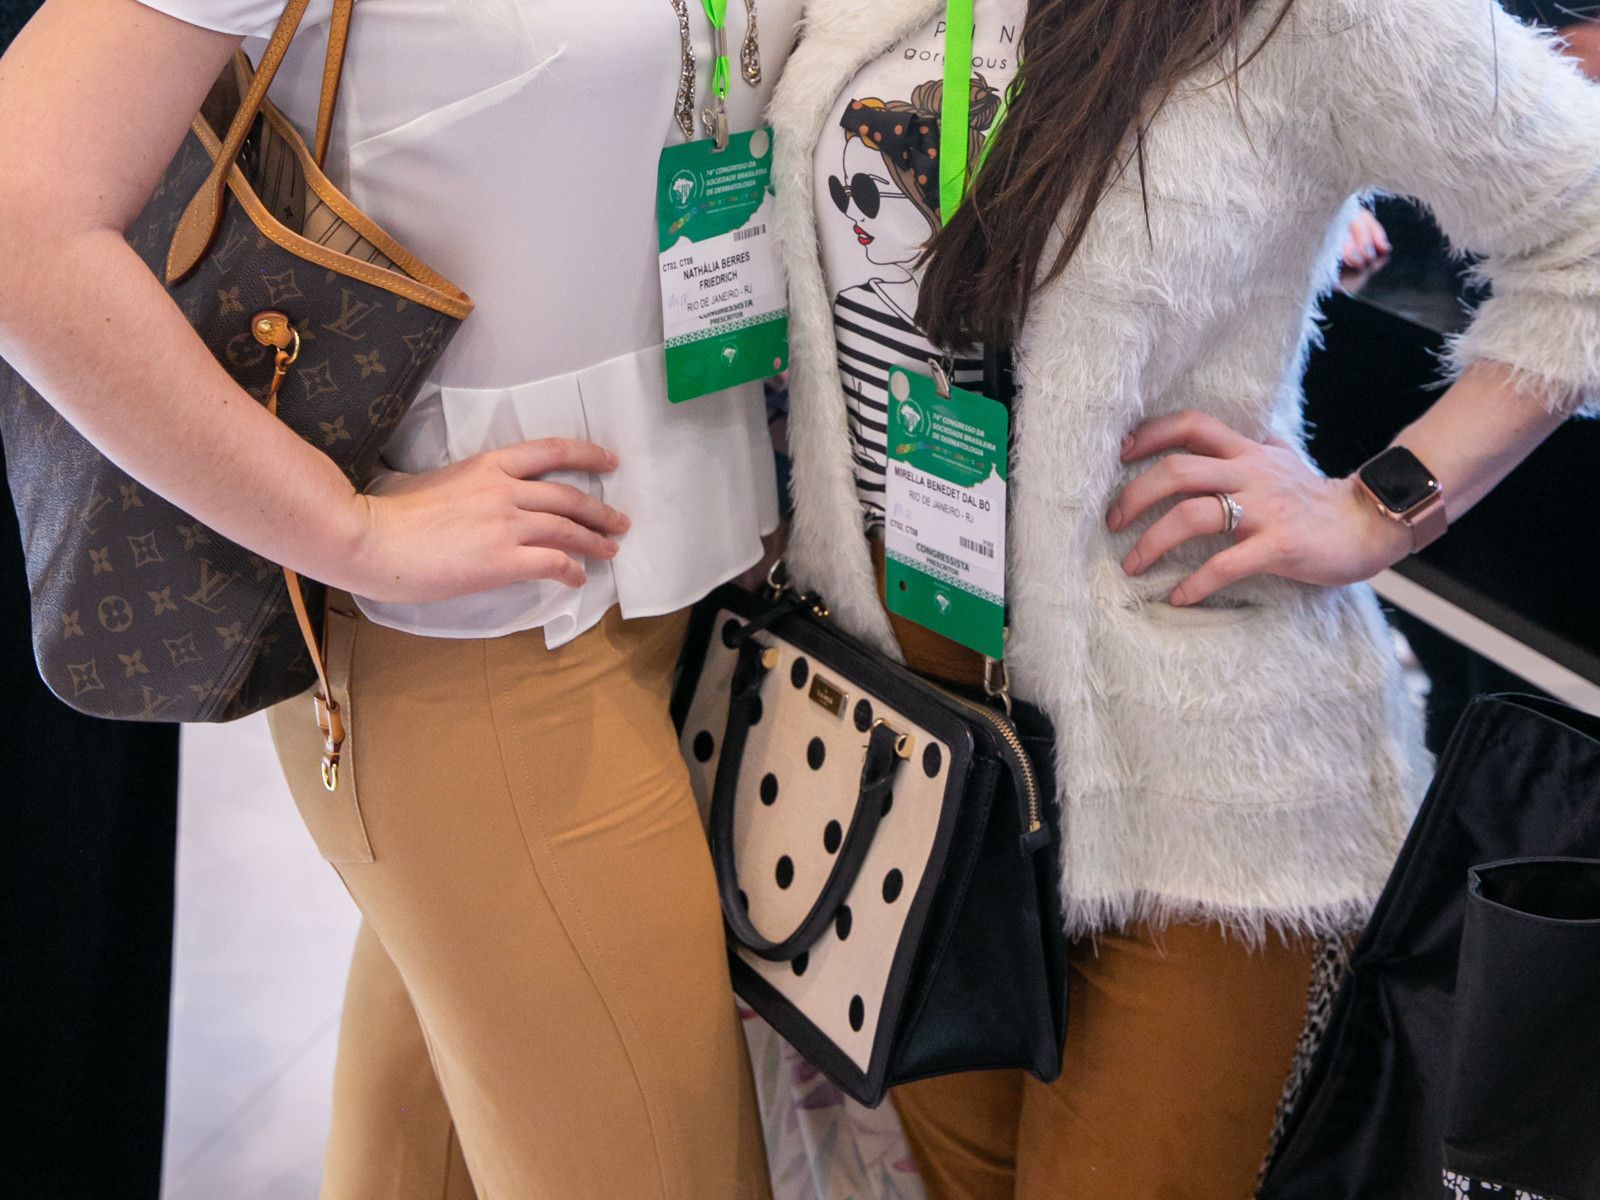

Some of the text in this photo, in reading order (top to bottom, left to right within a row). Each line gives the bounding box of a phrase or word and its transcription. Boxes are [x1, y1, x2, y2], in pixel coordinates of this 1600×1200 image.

[904, 48, 1007, 69] gorous
[706, 168, 767, 187] SOCIEDADE BRASILEIRA
[716, 163, 747, 175] CONGRESSO
[714, 179, 756, 194] DERMATOLOGIA
[683, 251, 751, 280] NATHÁLIA BERRES
[699, 270, 738, 290] FRIEDRICH
[687, 301, 699, 312] RIO
[700, 297, 709, 309] DE
[711, 288, 739, 305] JANEIRO
[744, 284, 753, 296] RJ
[942, 416, 976, 434] CONGRESSO
[932, 422, 996, 452] SOCIEDADE BRASILEIRA
[940, 436, 984, 456] DERMATOLOGIA
[894, 466, 925, 486] MIRELLA
[927, 479, 960, 500] BENEDET
[962, 492, 977, 507] DAL
[909, 490, 920, 502] RIO
[922, 495, 931, 506] DE
[932, 500, 960, 518] JANEIRO
[965, 512, 975, 523] RJ
[916, 542, 970, 572] CONGRESSISTA
